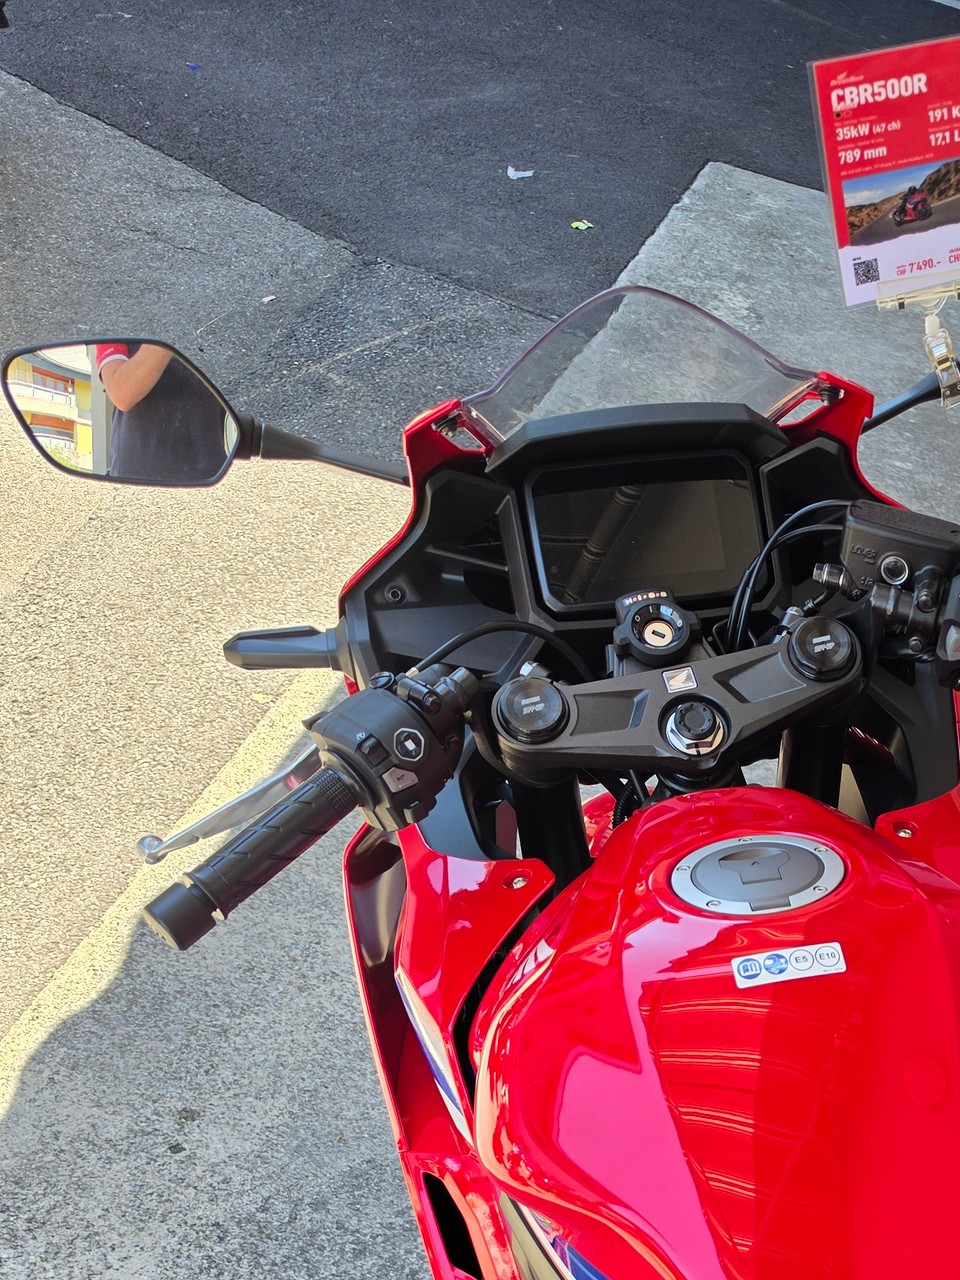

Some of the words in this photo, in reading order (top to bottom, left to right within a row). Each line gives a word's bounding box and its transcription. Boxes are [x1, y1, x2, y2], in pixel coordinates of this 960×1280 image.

[831, 73, 928, 110] CBR500R
[928, 107, 948, 123] 191
[835, 122, 870, 141] 35kW
[872, 123, 885, 135] (47
[887, 120, 901, 131] ch)
[929, 130, 950, 147] 17,1
[838, 149, 861, 165] 789
[863, 146, 888, 161] mm
[794, 955, 808, 964] E5
[818, 951, 836, 961] E10
